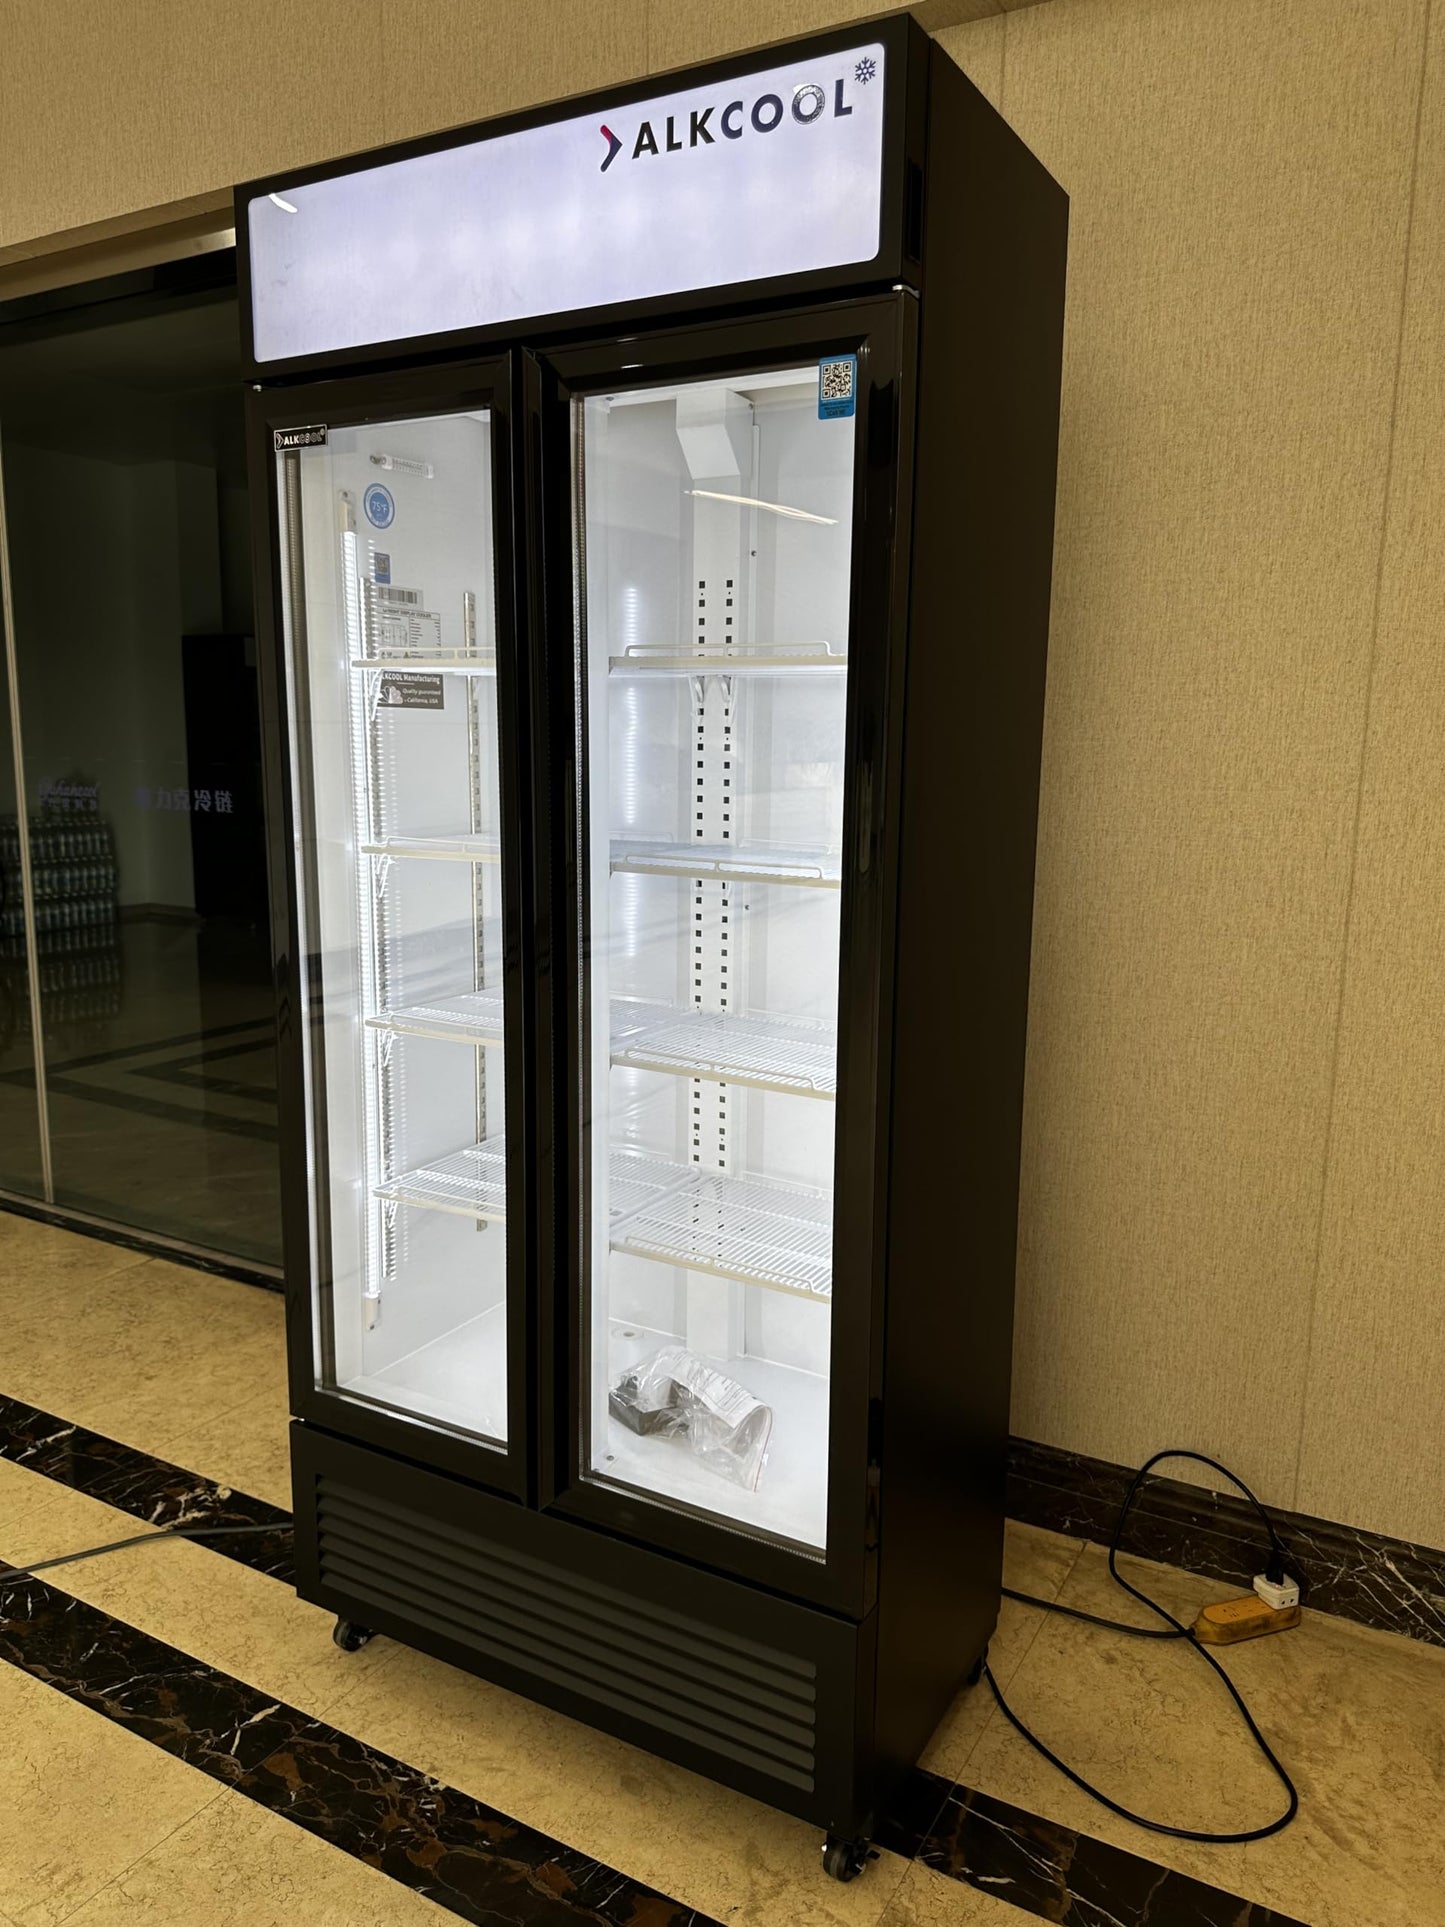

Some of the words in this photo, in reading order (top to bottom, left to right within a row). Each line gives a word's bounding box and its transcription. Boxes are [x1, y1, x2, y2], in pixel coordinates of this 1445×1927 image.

[632, 78, 853, 160] ALKCOOL
[284, 432, 323, 446] ALKCOOL
[382, 672, 403, 681] KCOOL
[403, 673, 440, 685] Manufacturing
